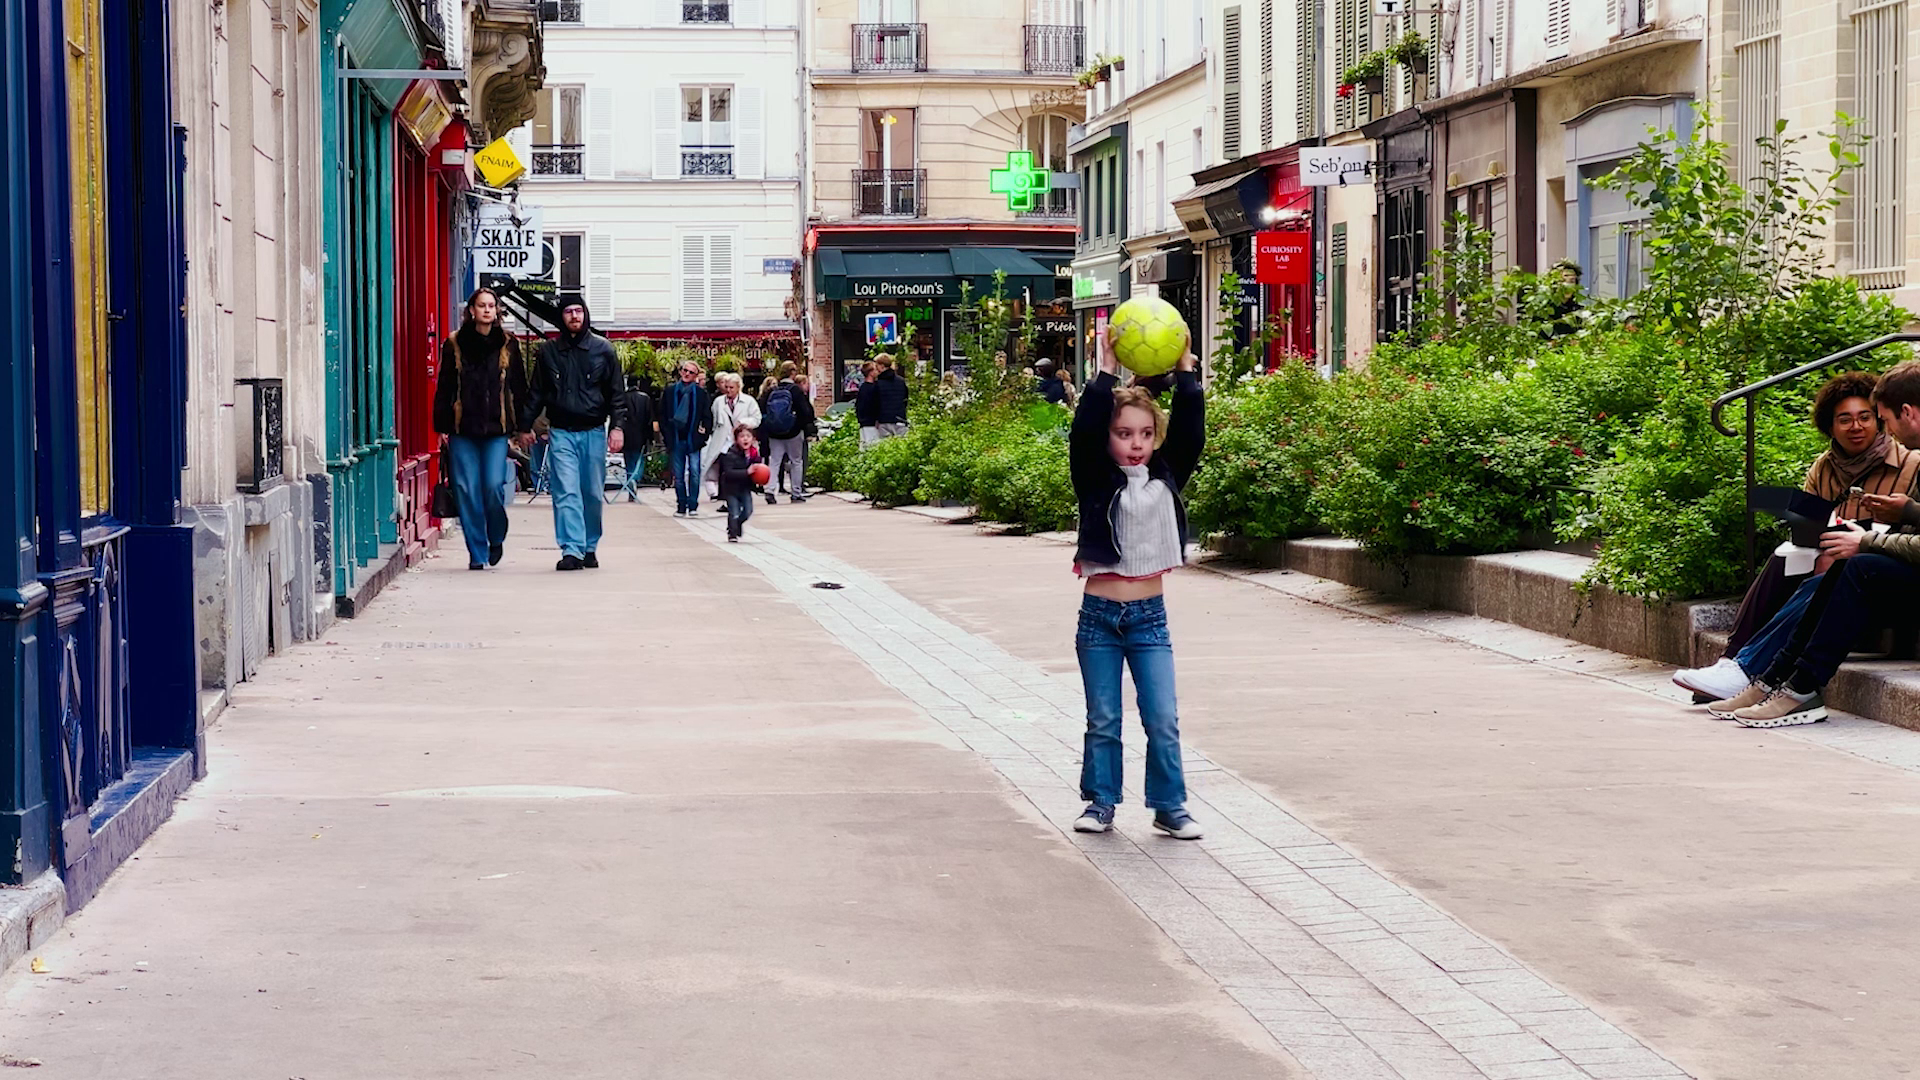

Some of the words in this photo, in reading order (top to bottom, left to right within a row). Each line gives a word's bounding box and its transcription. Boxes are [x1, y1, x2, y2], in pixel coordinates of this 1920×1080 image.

[480, 155, 515, 169] FNAIM
[1309, 156, 1362, 174] Seb'on
[481, 229, 536, 247] SKATE
[1260, 245, 1304, 254] CURIOSITY
[487, 250, 529, 268] SHOP
[1274, 254, 1290, 263] LAB
[1055, 263, 1073, 277] Lou
[854, 282, 876, 296] Lou
[881, 281, 945, 296] Pitchoun's
[1020, 321, 1043, 332] Lu
[1046, 321, 1077, 332] Pitch
